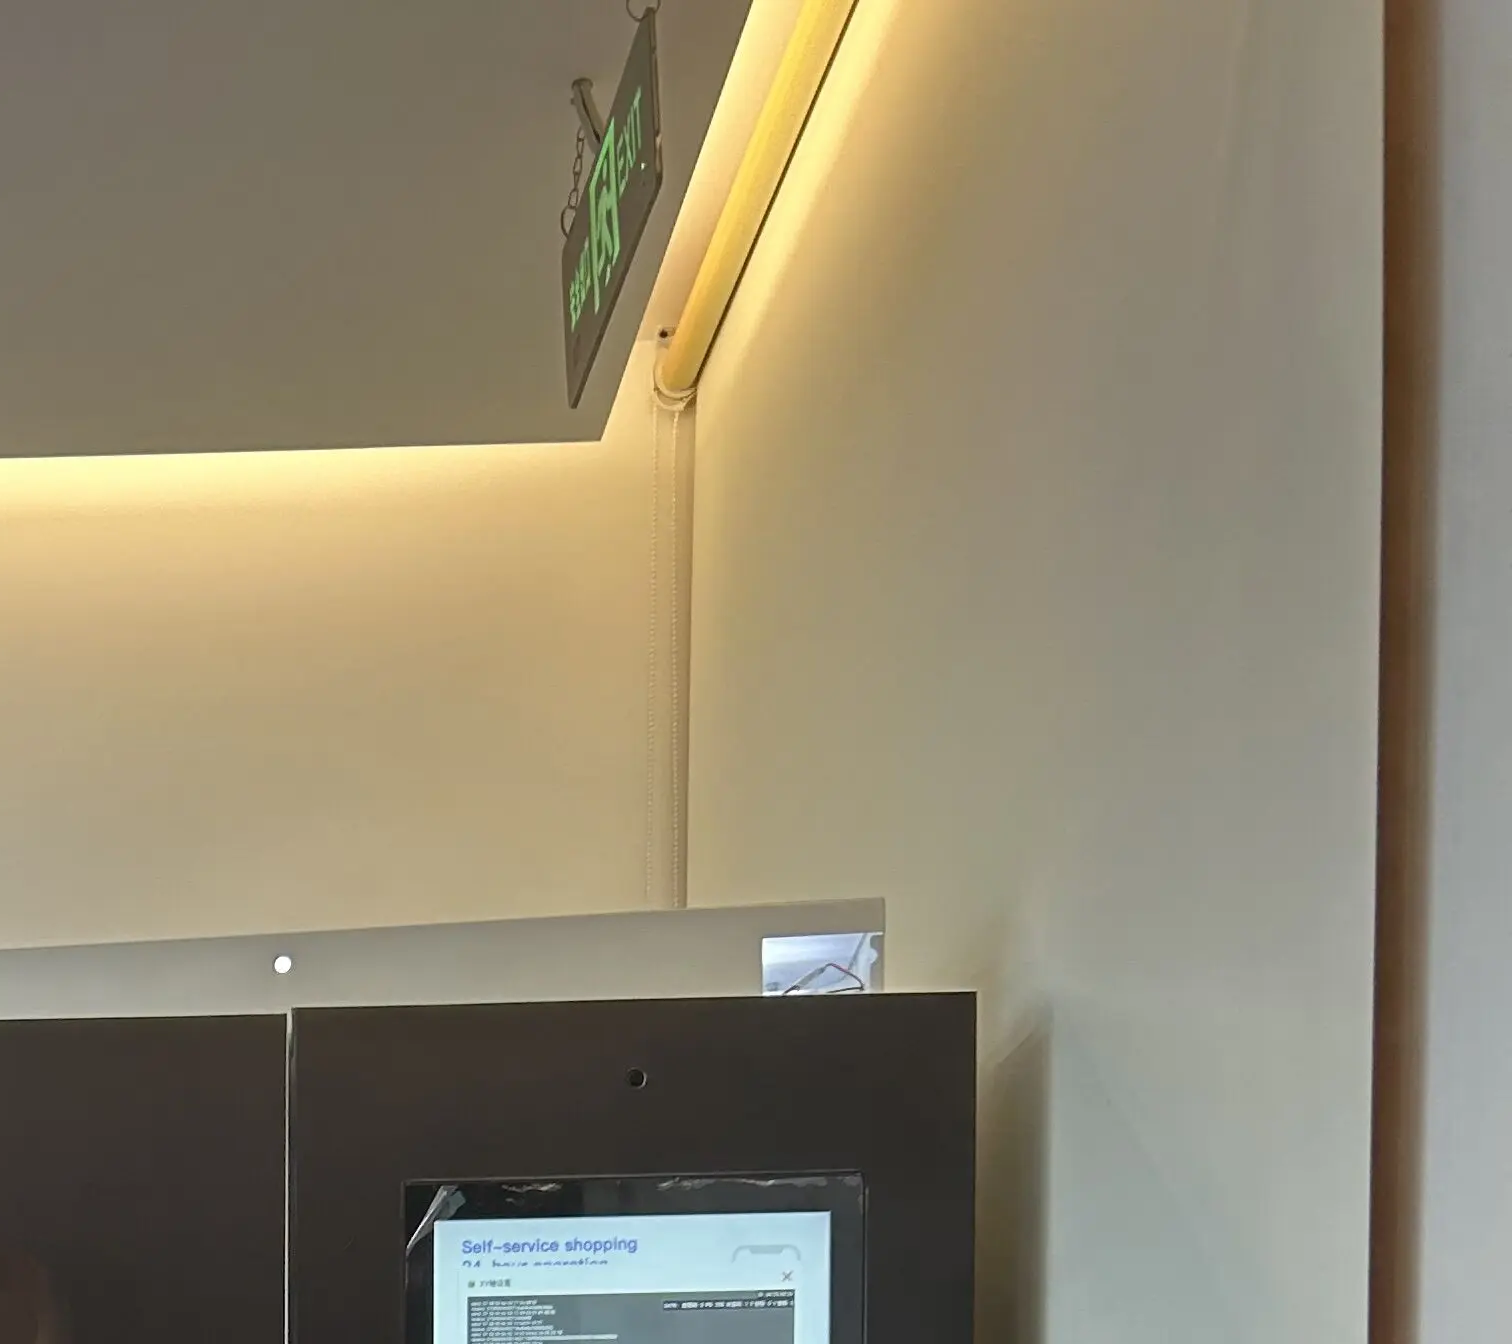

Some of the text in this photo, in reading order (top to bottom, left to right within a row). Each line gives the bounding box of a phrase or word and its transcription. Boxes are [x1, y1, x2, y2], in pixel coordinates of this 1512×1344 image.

[617, 85, 641, 198] EXIT
[462, 1236, 638, 1254] Self-service shopping
